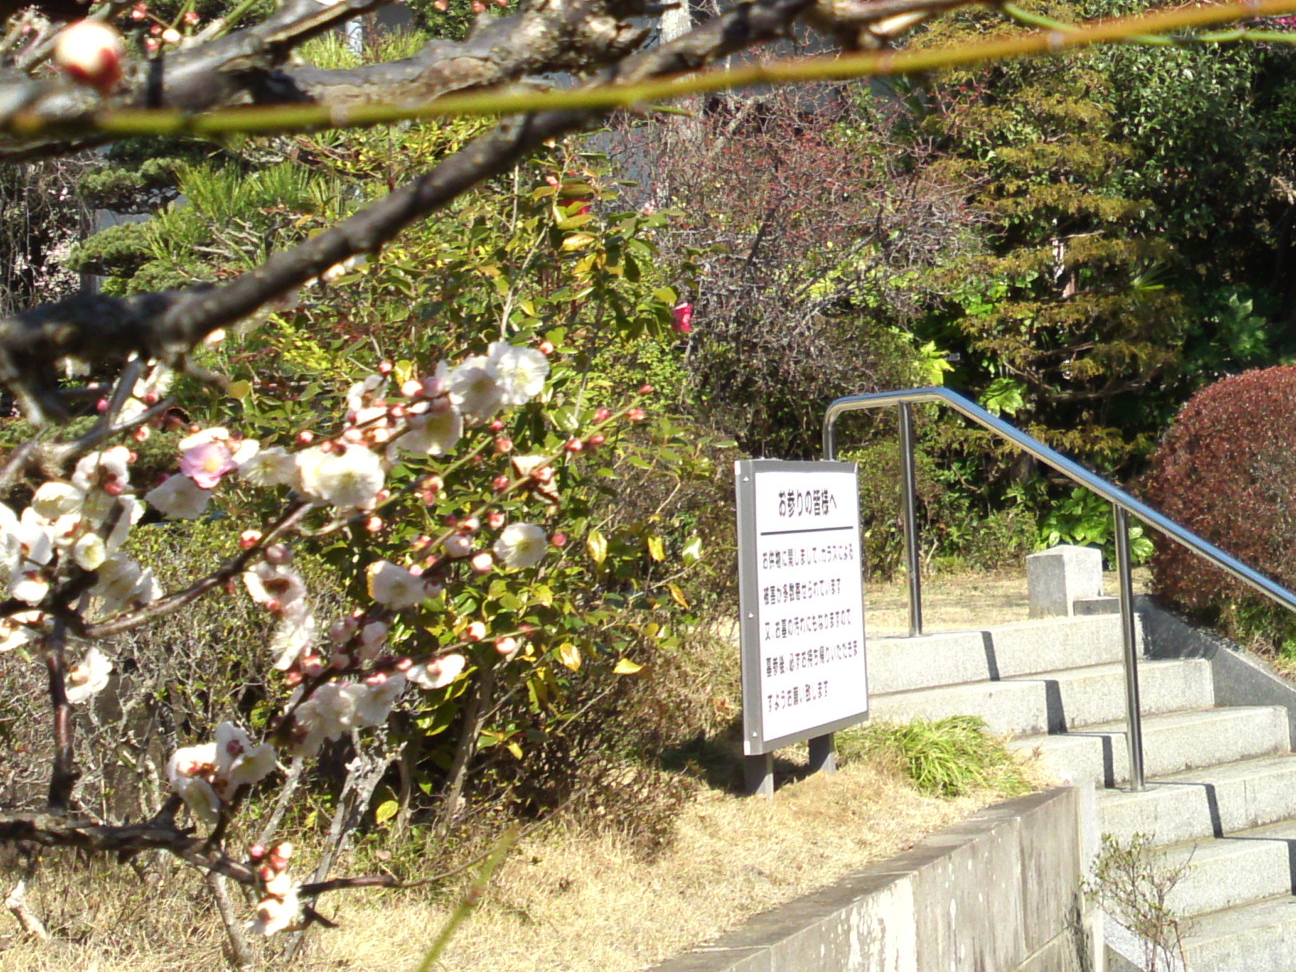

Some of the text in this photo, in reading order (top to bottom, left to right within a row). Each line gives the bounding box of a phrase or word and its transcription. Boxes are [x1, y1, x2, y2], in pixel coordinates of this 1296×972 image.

[778, 488, 837, 518] お参りの皆様へ
